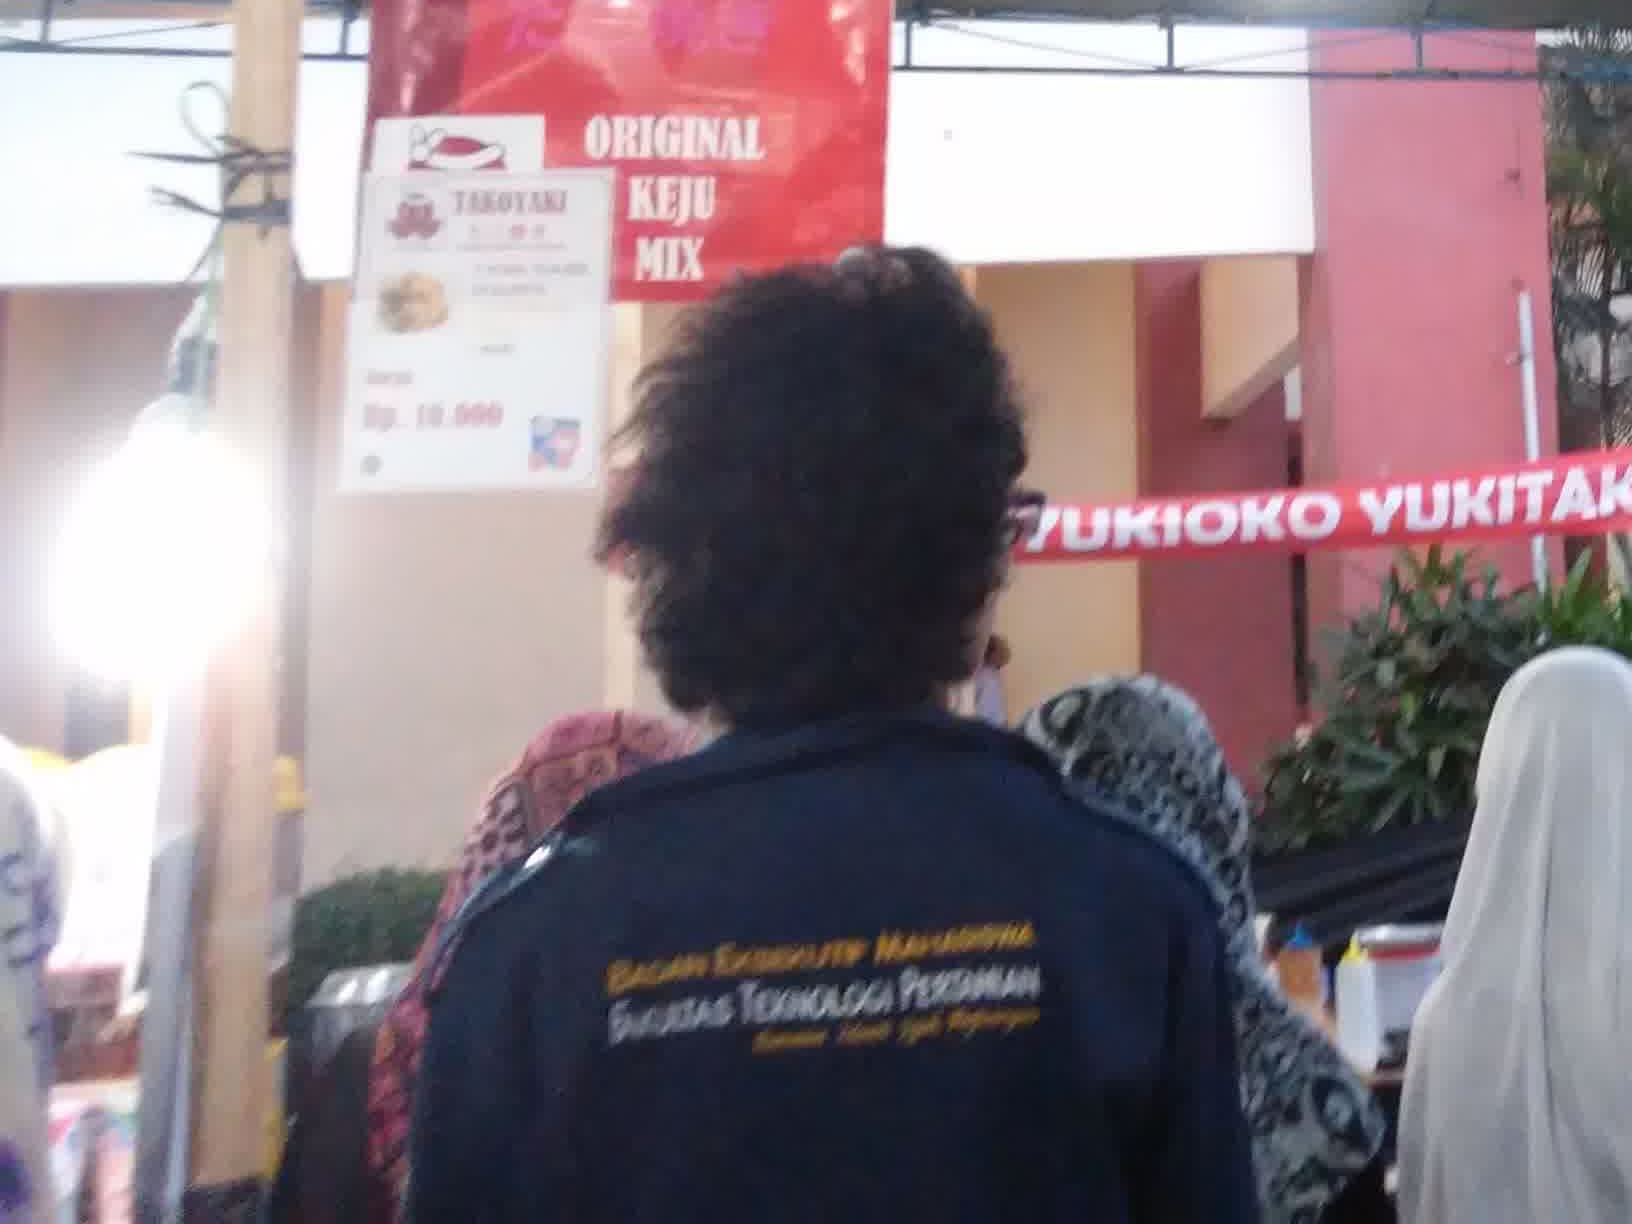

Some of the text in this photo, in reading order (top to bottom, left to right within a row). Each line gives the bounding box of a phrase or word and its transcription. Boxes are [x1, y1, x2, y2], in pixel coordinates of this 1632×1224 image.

[584, 113, 765, 161] ORIGINAL
[627, 176, 717, 227] KEJU
[635, 237, 704, 282] MIX
